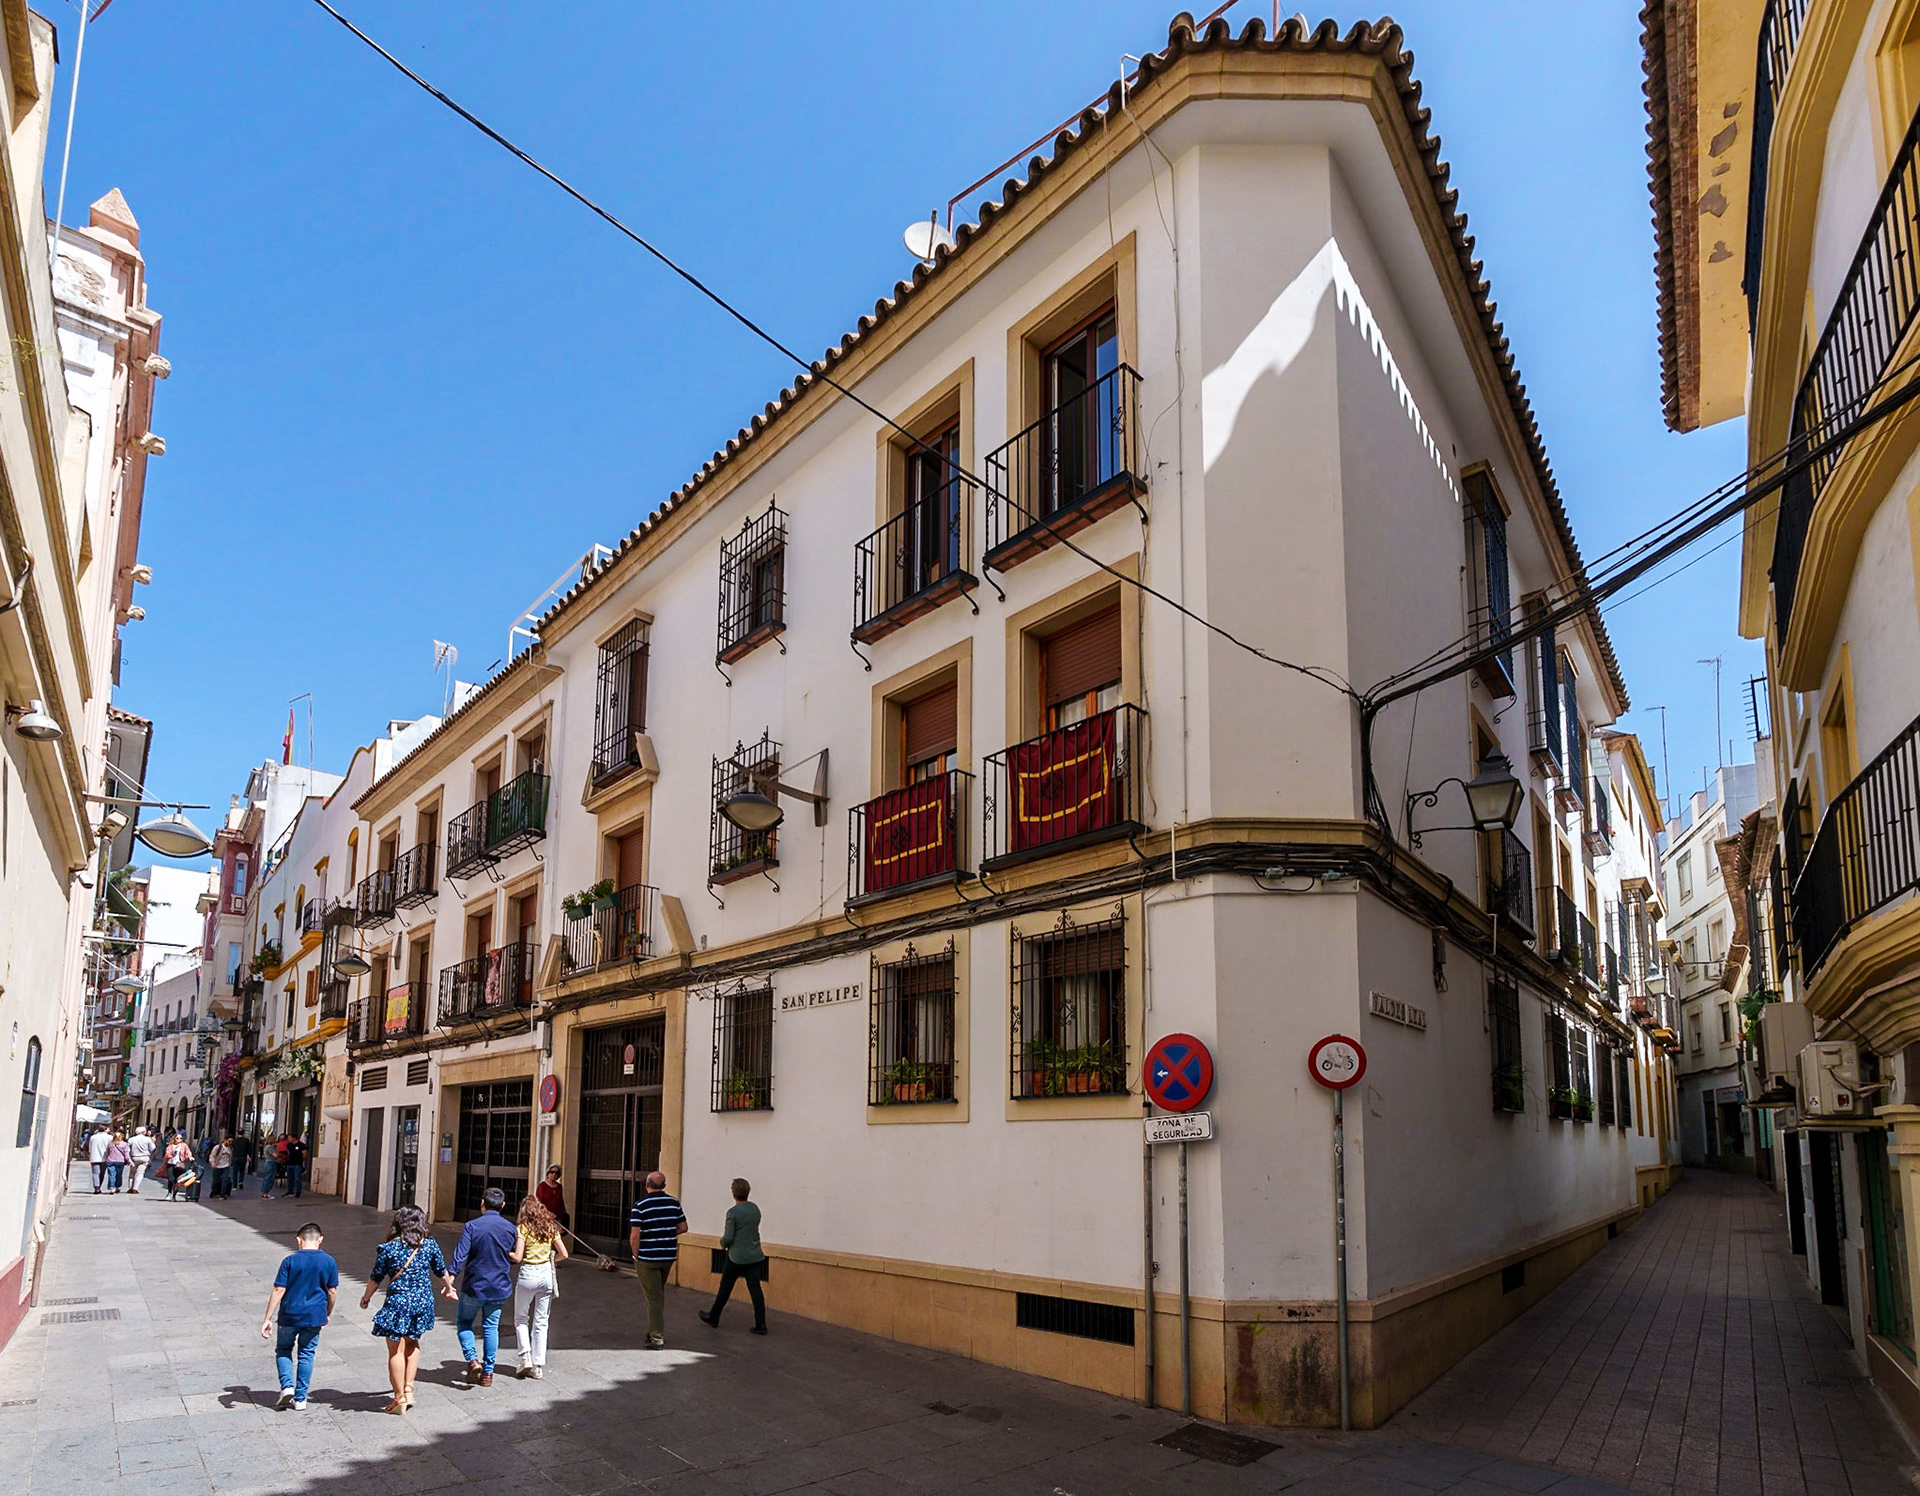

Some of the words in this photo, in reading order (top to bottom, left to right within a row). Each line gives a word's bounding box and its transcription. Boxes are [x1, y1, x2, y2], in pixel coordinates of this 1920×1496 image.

[782, 995, 804, 1010] SAN
[809, 985, 860, 1005] FELIPE
[1156, 1119, 1181, 1128] ZONA
[1184, 1117, 1196, 1126] DE
